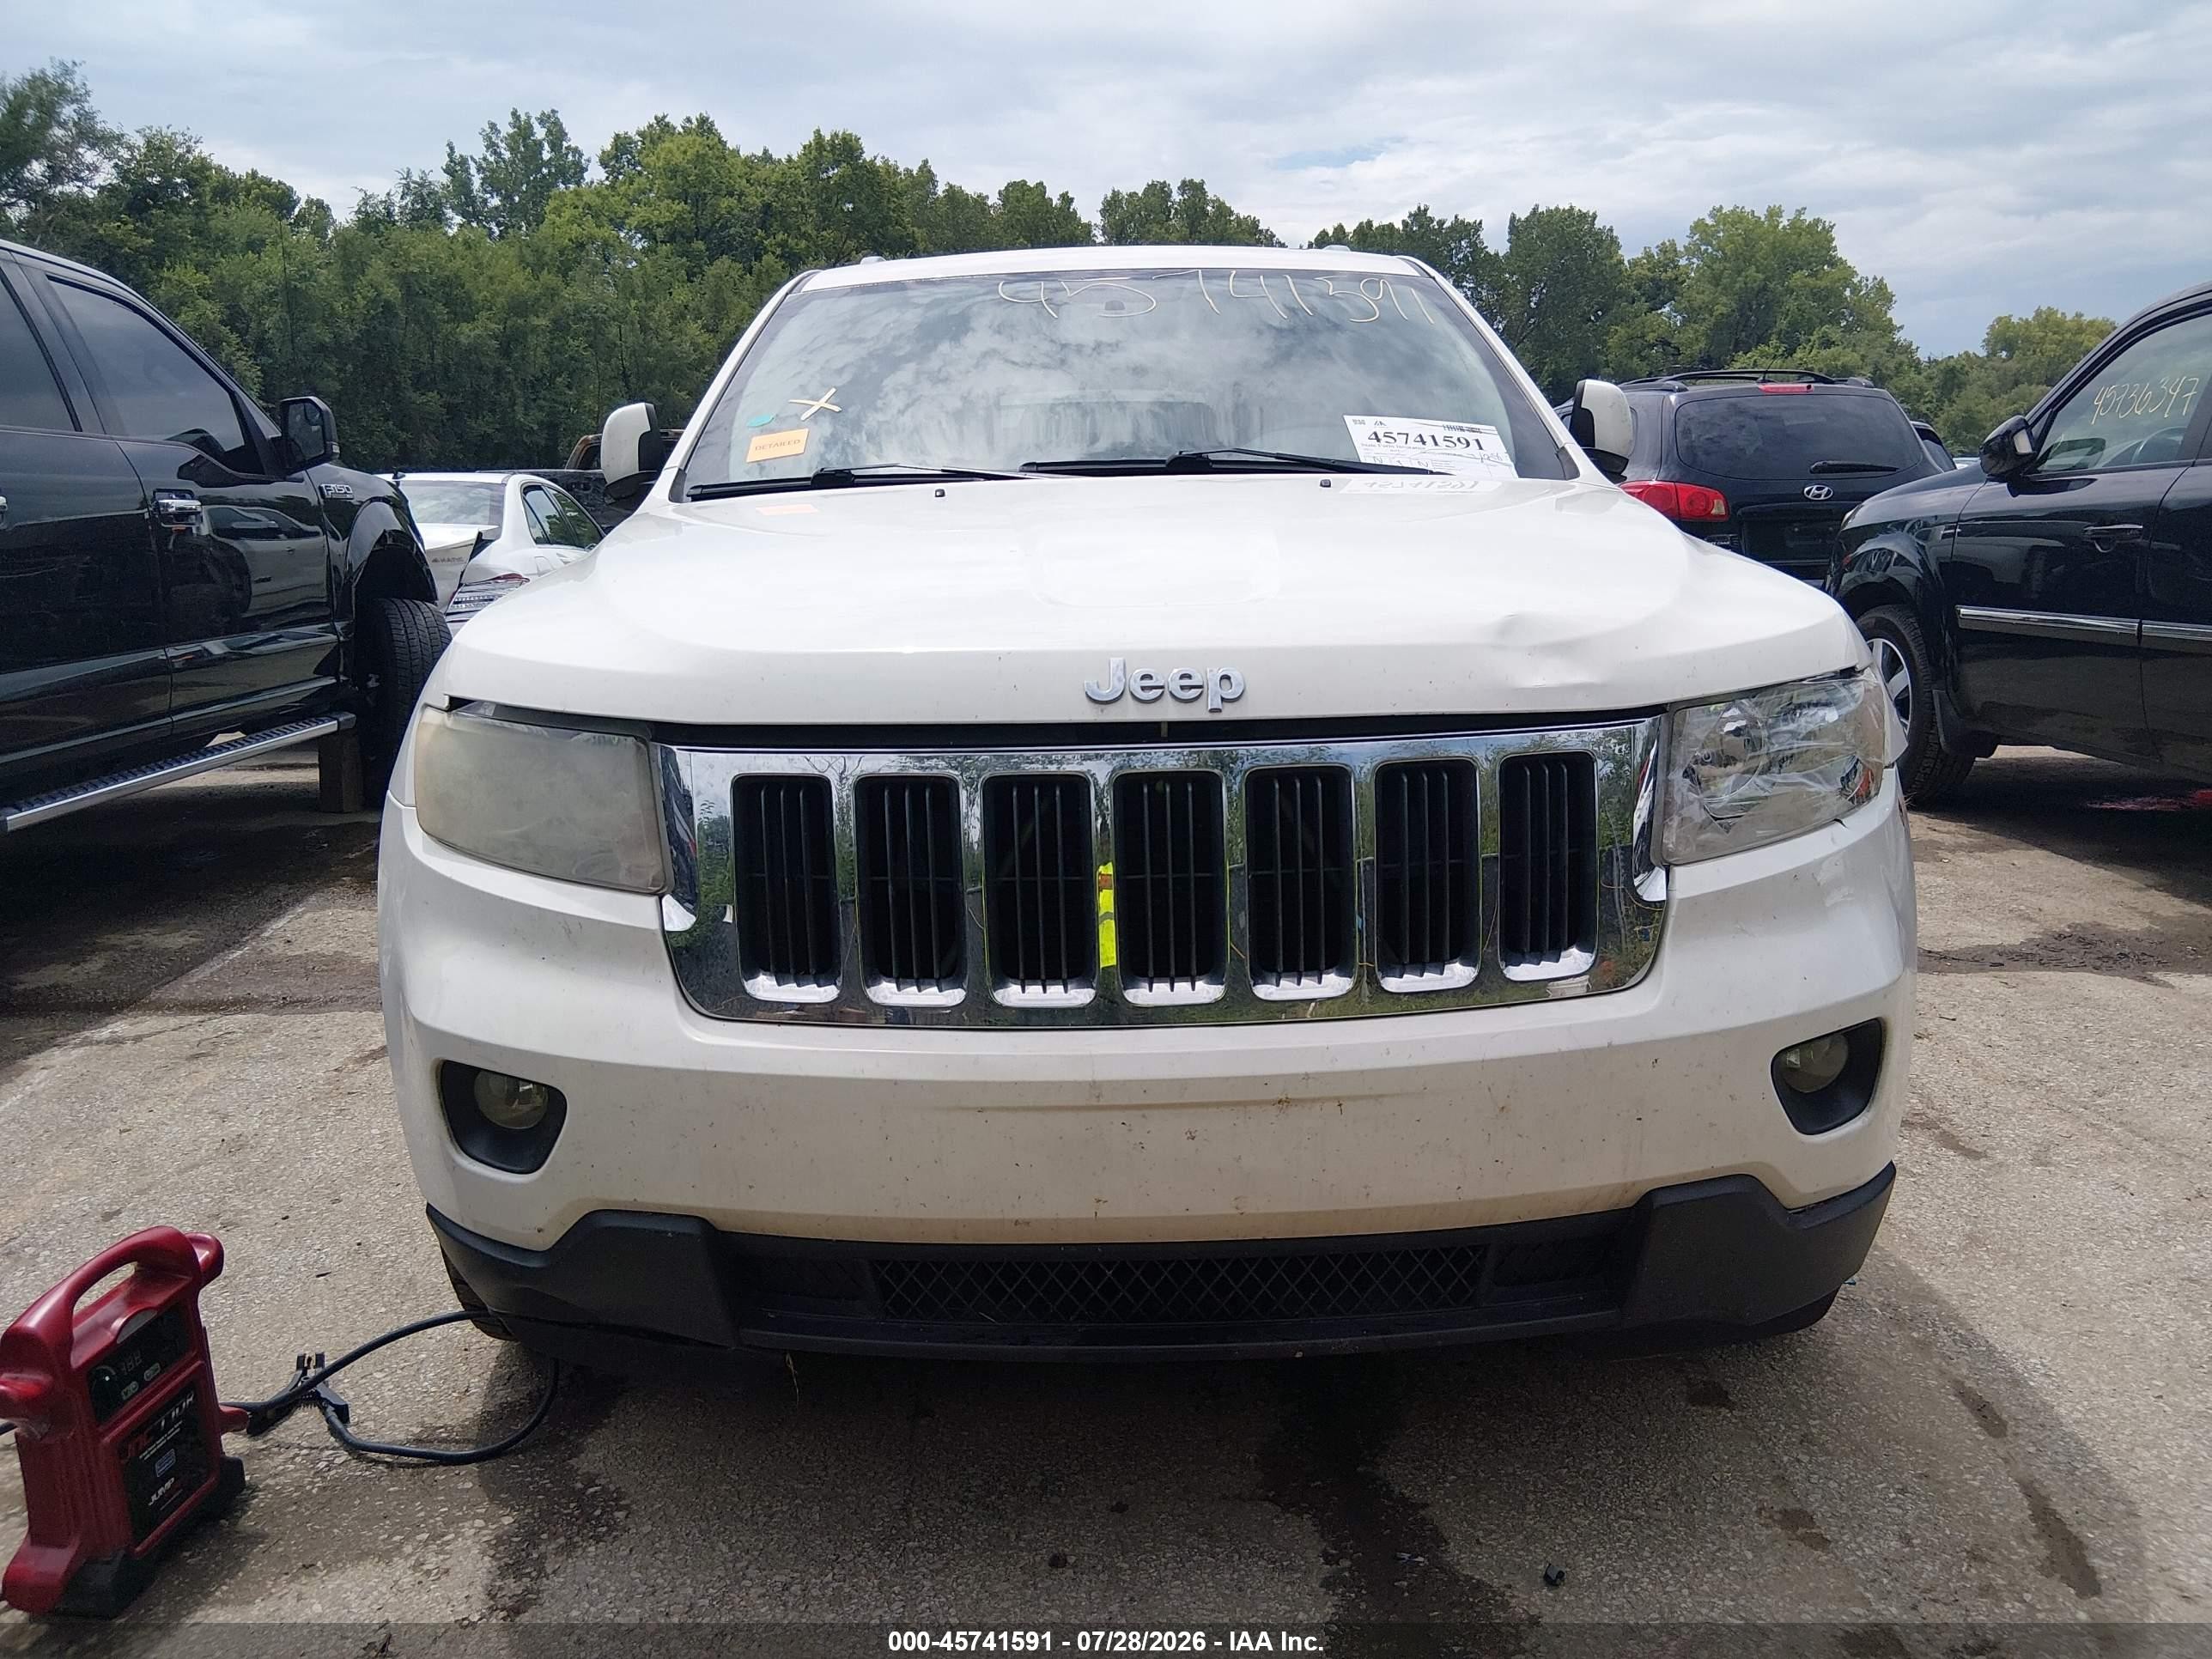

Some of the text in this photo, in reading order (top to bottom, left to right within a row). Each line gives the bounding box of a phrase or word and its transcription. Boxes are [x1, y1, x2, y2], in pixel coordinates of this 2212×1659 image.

[999, 269, 1435, 325] 45741591
[2091, 376, 2199, 425] 45736347
[755, 439, 801, 451] DETAILED
[1368, 431, 1485, 451] 45741591
[1084, 657, 1245, 714] Jeep
